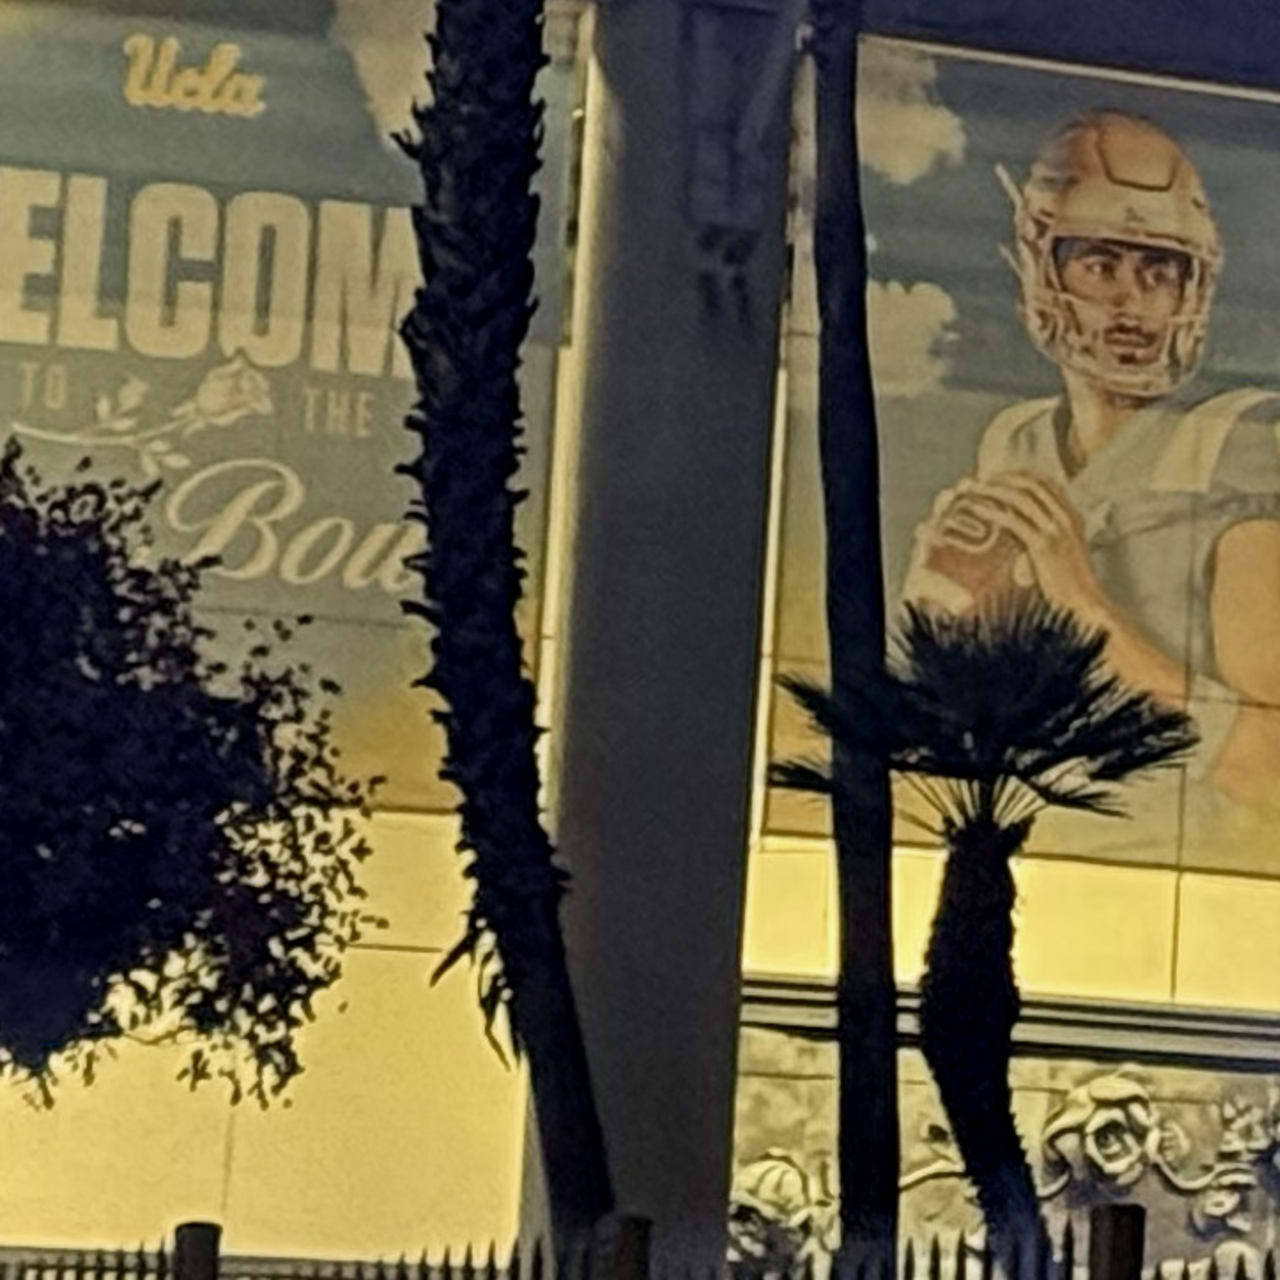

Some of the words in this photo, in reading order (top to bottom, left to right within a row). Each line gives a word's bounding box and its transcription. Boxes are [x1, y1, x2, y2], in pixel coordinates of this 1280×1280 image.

[124, 34, 266, 117] Ucla
[0, 166, 420, 378] ELCOM
[18, 361, 68, 410] TO
[305, 387, 374, 438] THE
